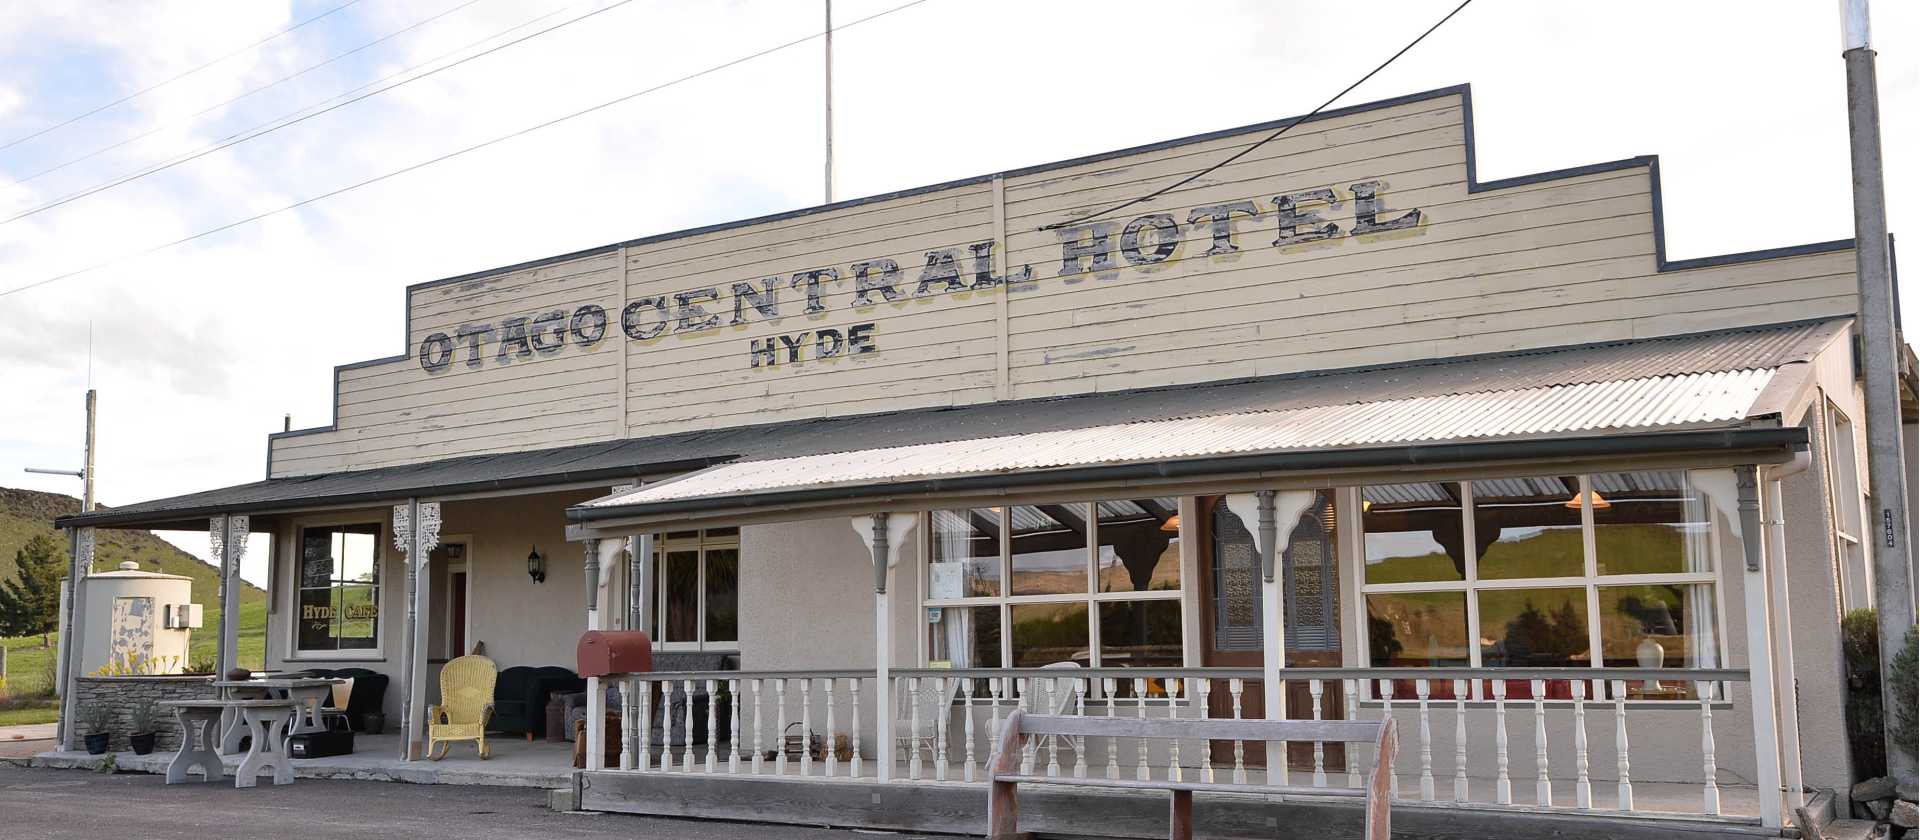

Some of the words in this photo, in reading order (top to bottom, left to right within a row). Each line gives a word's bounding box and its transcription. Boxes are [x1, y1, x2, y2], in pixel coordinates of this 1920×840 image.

[419, 304, 607, 372] OTAGO
[621, 240, 1037, 341] CENTRAL
[1058, 181, 1423, 278] HOTEL
[749, 322, 877, 368] HYDE
